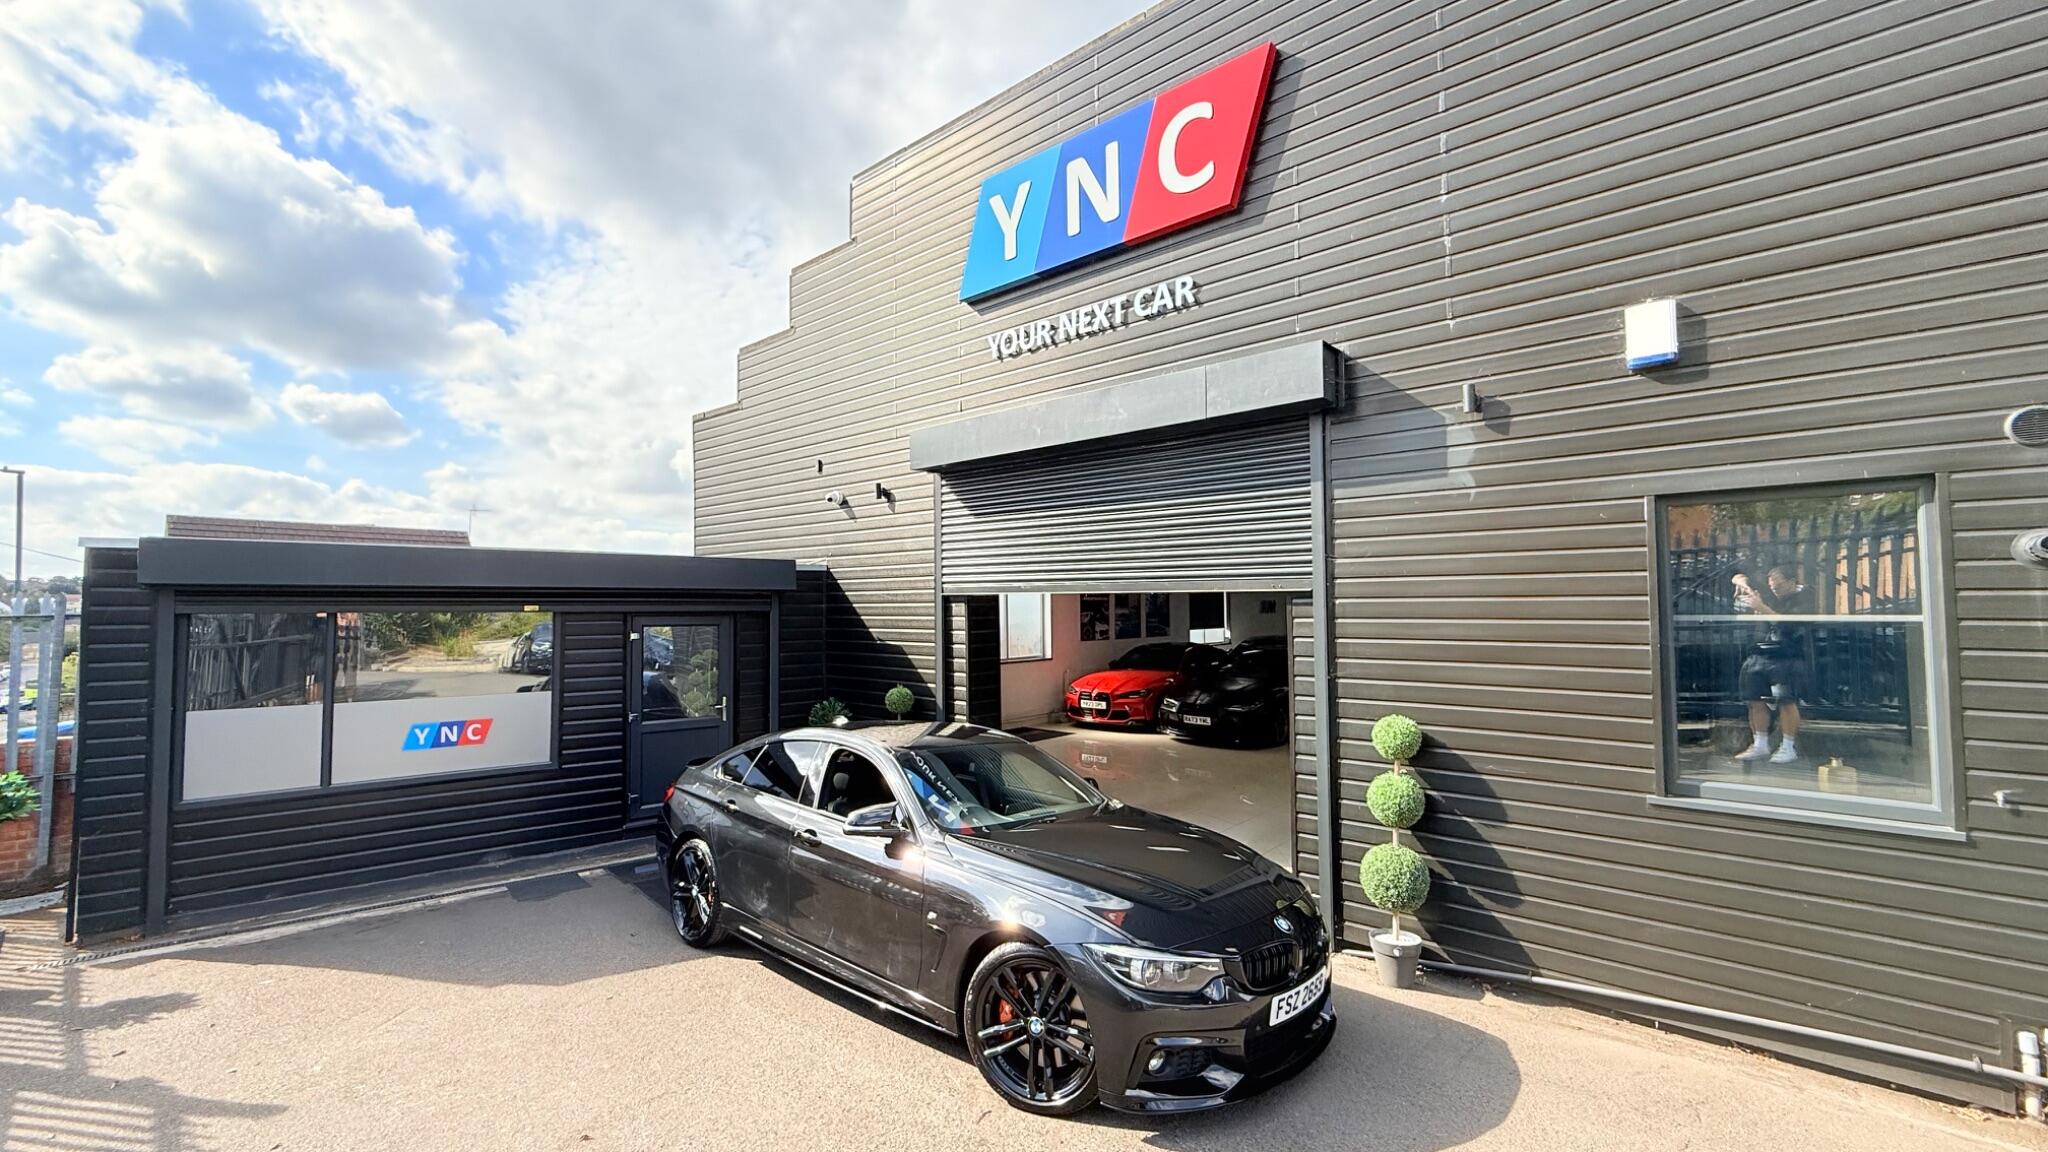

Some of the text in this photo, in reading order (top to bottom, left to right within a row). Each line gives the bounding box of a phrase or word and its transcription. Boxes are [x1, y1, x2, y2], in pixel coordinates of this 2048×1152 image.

[989, 101, 1214, 261] YNC
[987, 275, 1196, 359] YOUR NEXT CAR
[414, 724, 481, 745] YNC
[1276, 990, 1301, 1020] FSZ
